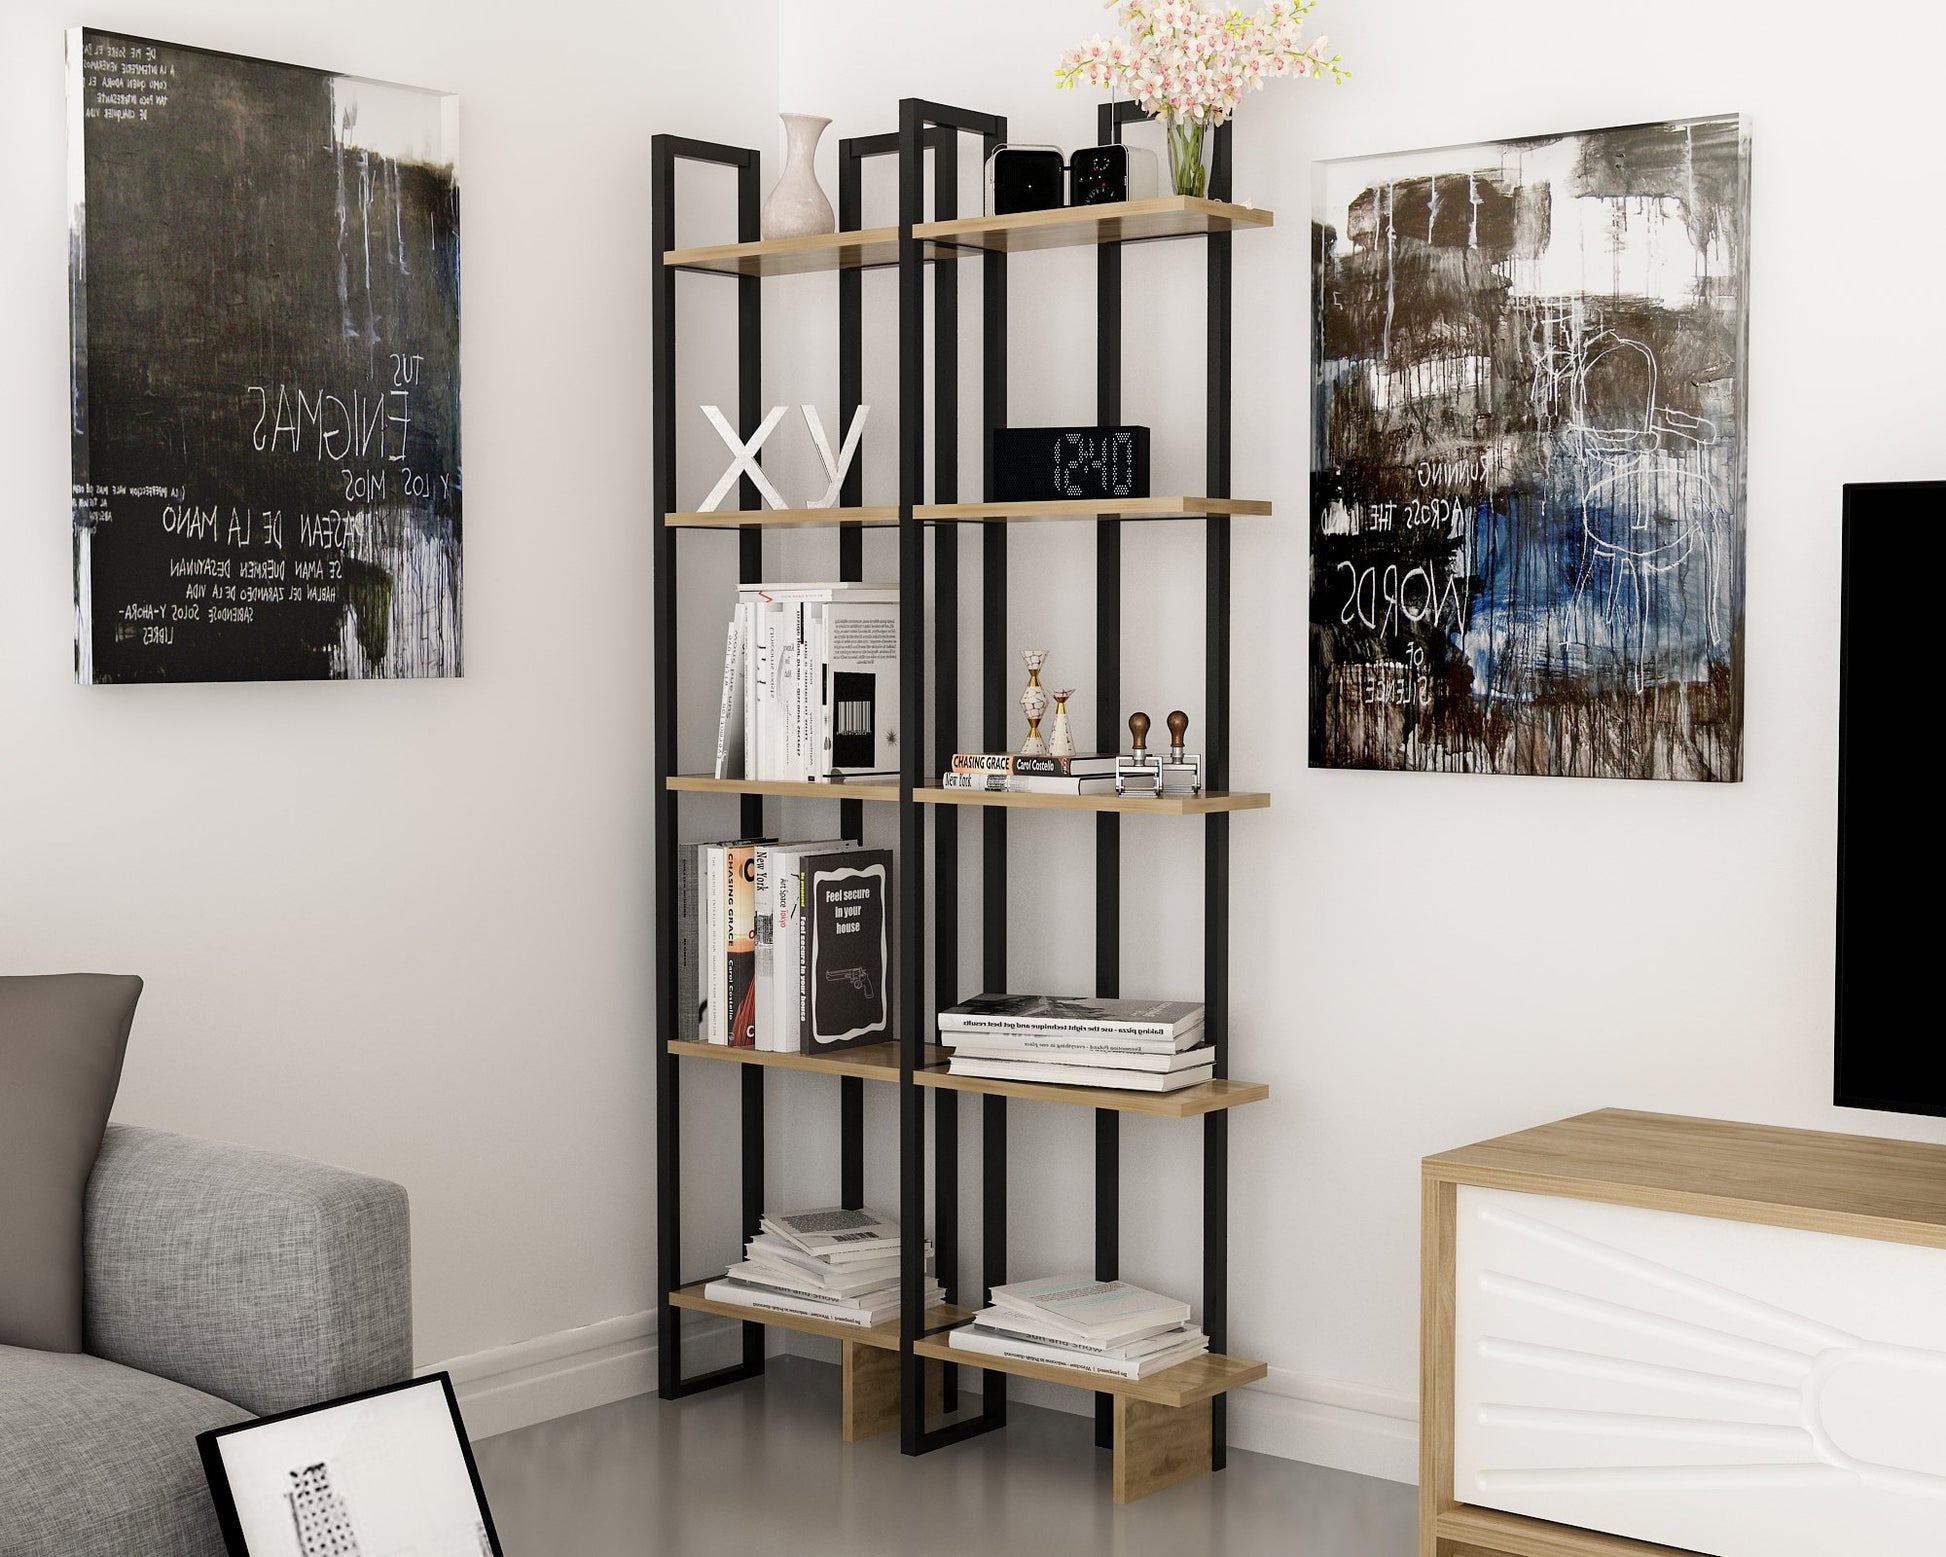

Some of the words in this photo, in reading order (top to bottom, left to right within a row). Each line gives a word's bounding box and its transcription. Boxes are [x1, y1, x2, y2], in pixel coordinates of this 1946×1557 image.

[953, 755, 985, 769] CHASING
[986, 757, 1010, 771] GRACE
[1016, 758, 1031, 771] Carol
[1031, 759, 1055, 773] Costello
[756, 851, 767, 871] New
[755, 872, 768, 892] York
[780, 878, 788, 889] Art
[779, 889, 788, 908] Space
[826, 889, 842, 903] Feel
[843, 888, 870, 901] secure
[779, 910, 788, 929] Tokyo
[835, 906, 843, 918] in
[843, 905, 862, 919] your
[836, 922, 861, 935] house
